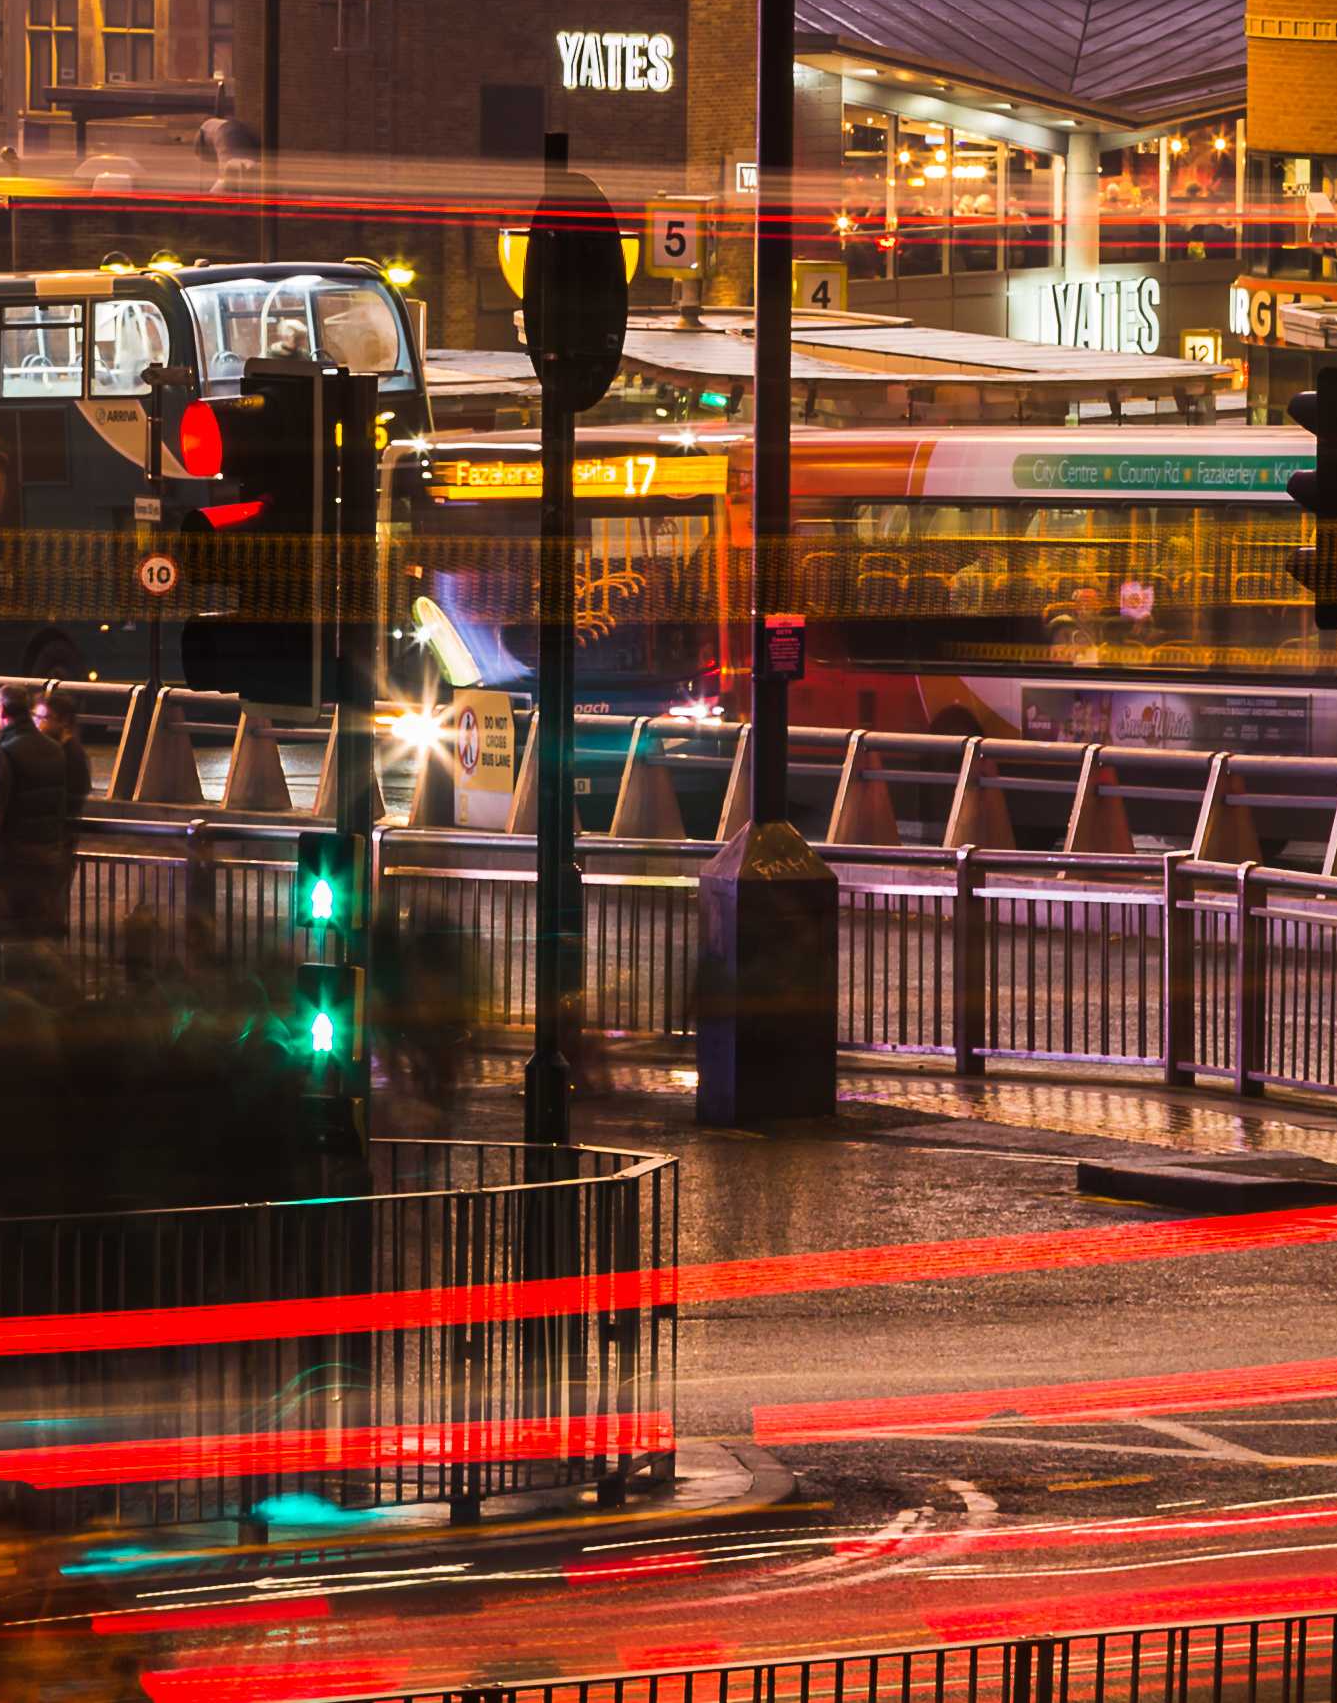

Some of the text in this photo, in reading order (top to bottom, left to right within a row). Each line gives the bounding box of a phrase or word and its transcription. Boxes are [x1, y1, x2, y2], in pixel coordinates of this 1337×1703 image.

[557, 31, 674, 92] YATES
[664, 220, 686, 257] 5
[811, 280, 831, 309] 4
[1048, 276, 1160, 355] YATES
[1188, 344, 1209, 362] 12
[107, 409, 139, 422] ARRIVA
[624, 456, 657, 495] 17
[1032, 460, 1055, 487] City
[1058, 460, 1097, 483] Centre
[1118, 461, 1161, 489] County
[1165, 461, 1179, 483] Rd
[1197, 461, 1256, 490] Fazakerley
[147, 566, 171, 584] 10
[484, 716, 507, 730] DO NOT
[1117, 706, 1192, 740] Snow White
[486, 735, 506, 749] CROSS
[482, 753, 510, 768] BUS LANE
